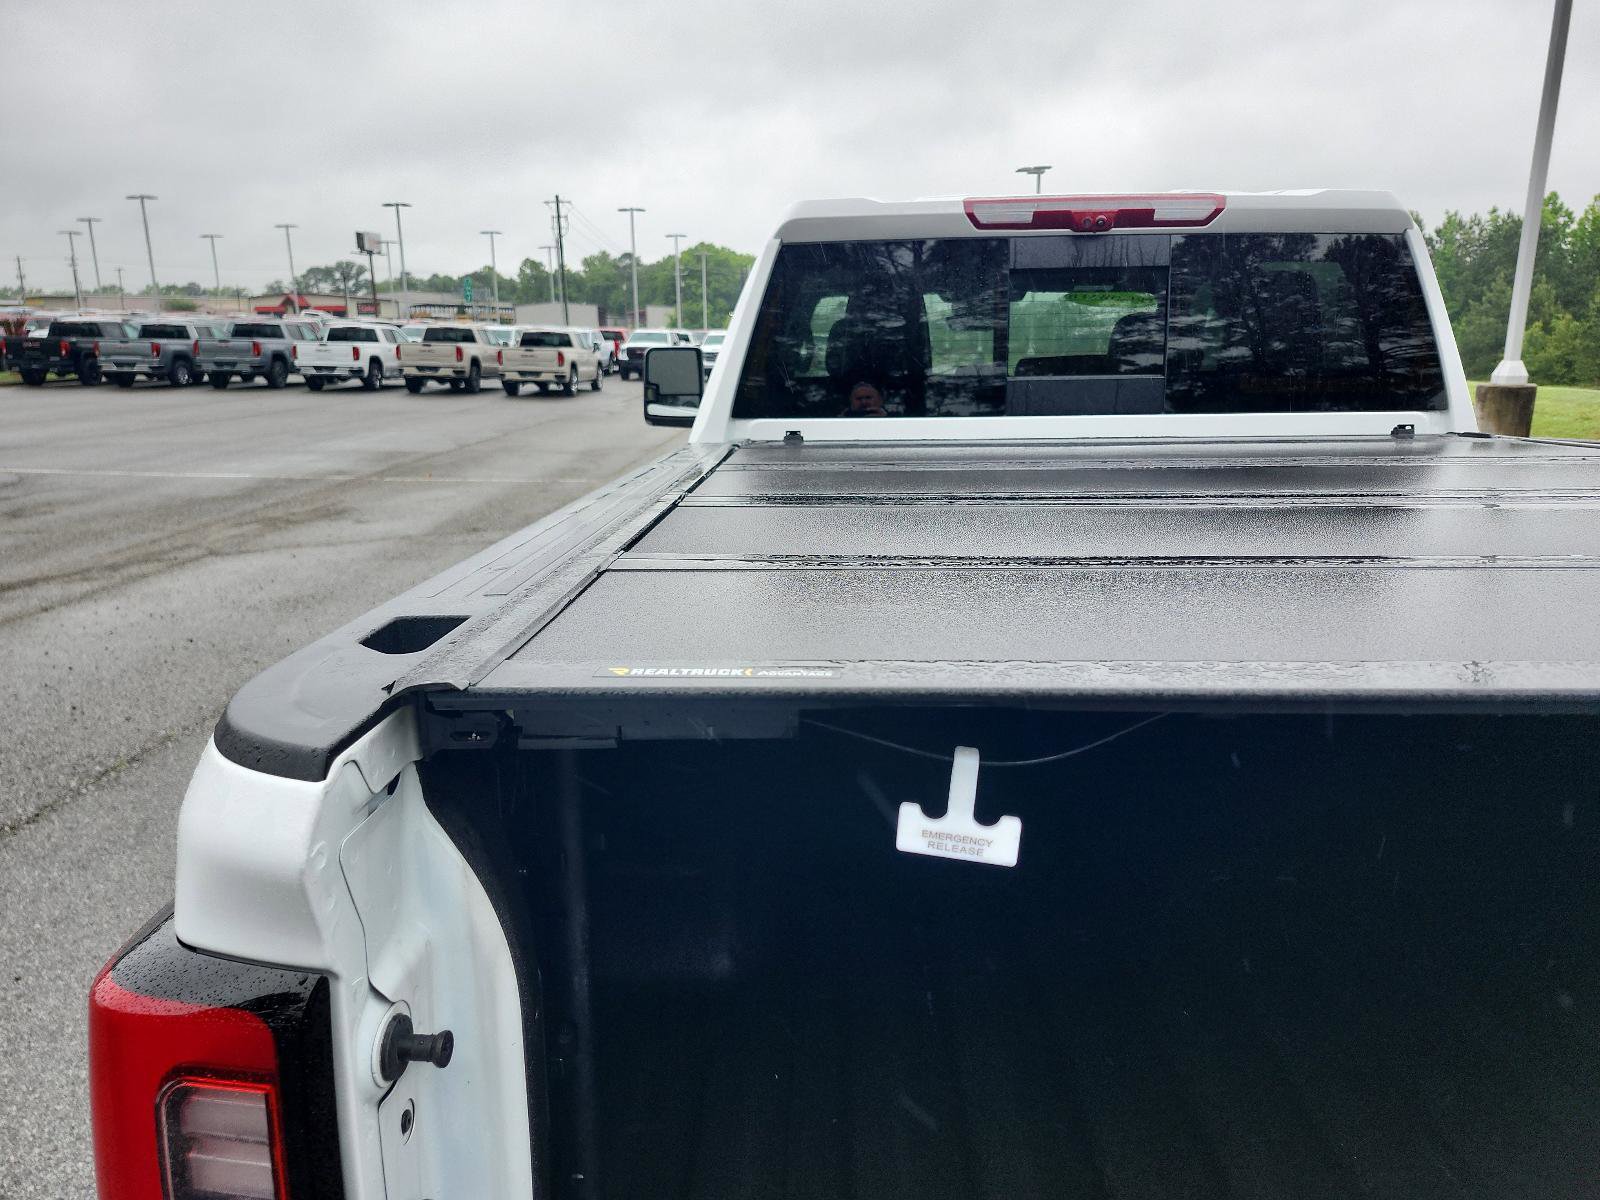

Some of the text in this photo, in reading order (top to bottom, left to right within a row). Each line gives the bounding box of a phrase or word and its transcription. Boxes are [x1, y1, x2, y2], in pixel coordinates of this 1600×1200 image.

[630, 668, 744, 676] REALTRUCK
[922, 830, 993, 847] EMERGENCY
[927, 841, 984, 856] RELEASE
